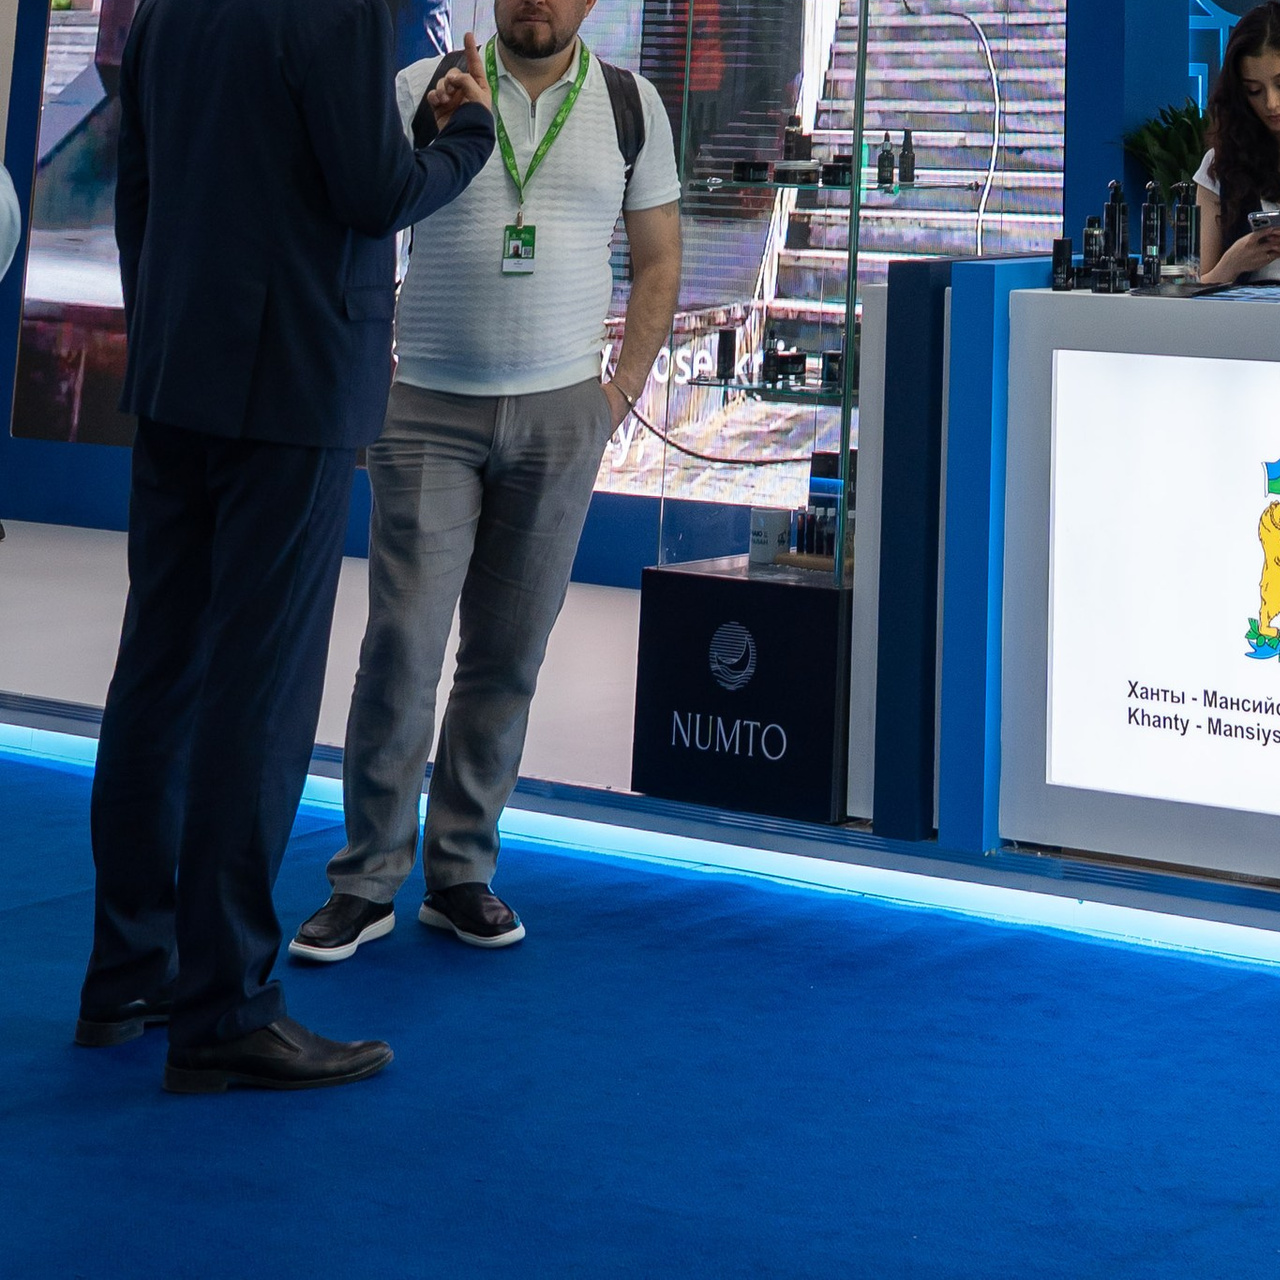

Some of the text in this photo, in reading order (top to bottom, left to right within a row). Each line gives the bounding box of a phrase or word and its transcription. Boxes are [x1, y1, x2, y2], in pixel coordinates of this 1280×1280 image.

[1128, 680, 1185, 704] Ханты
[671, 710, 787, 761] NUMTO
[1127, 707, 1190, 736] Khanty
